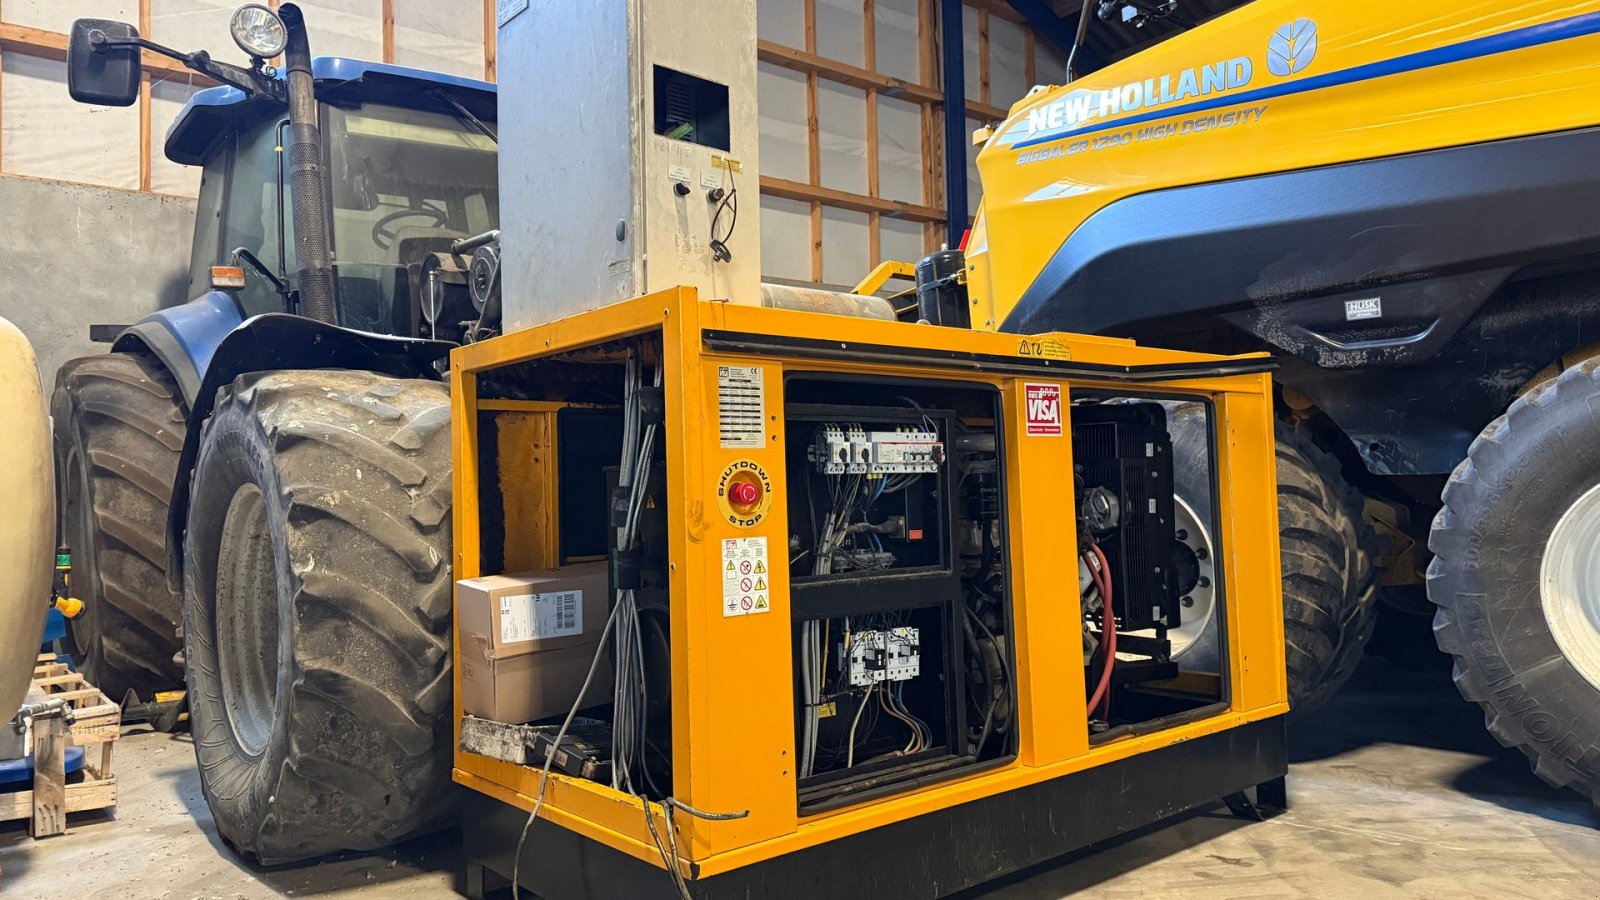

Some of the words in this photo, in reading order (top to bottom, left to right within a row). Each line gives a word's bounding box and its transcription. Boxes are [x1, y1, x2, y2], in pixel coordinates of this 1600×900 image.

[1028, 95, 1092, 133] NEW
[1100, 56, 1252, 118] HOLLAND
[1016, 140, 1089, 166] BIGBALER
[1092, 131, 1133, 150] 1290
[1135, 123, 1178, 143] HIGH
[1179, 105, 1268, 135] DENSITY
[1350, 300, 1376, 310] HUSK
[1029, 399, 1058, 423] VISA
[718, 461, 771, 497] SHUTDOWN
[729, 514, 762, 527] STOP
